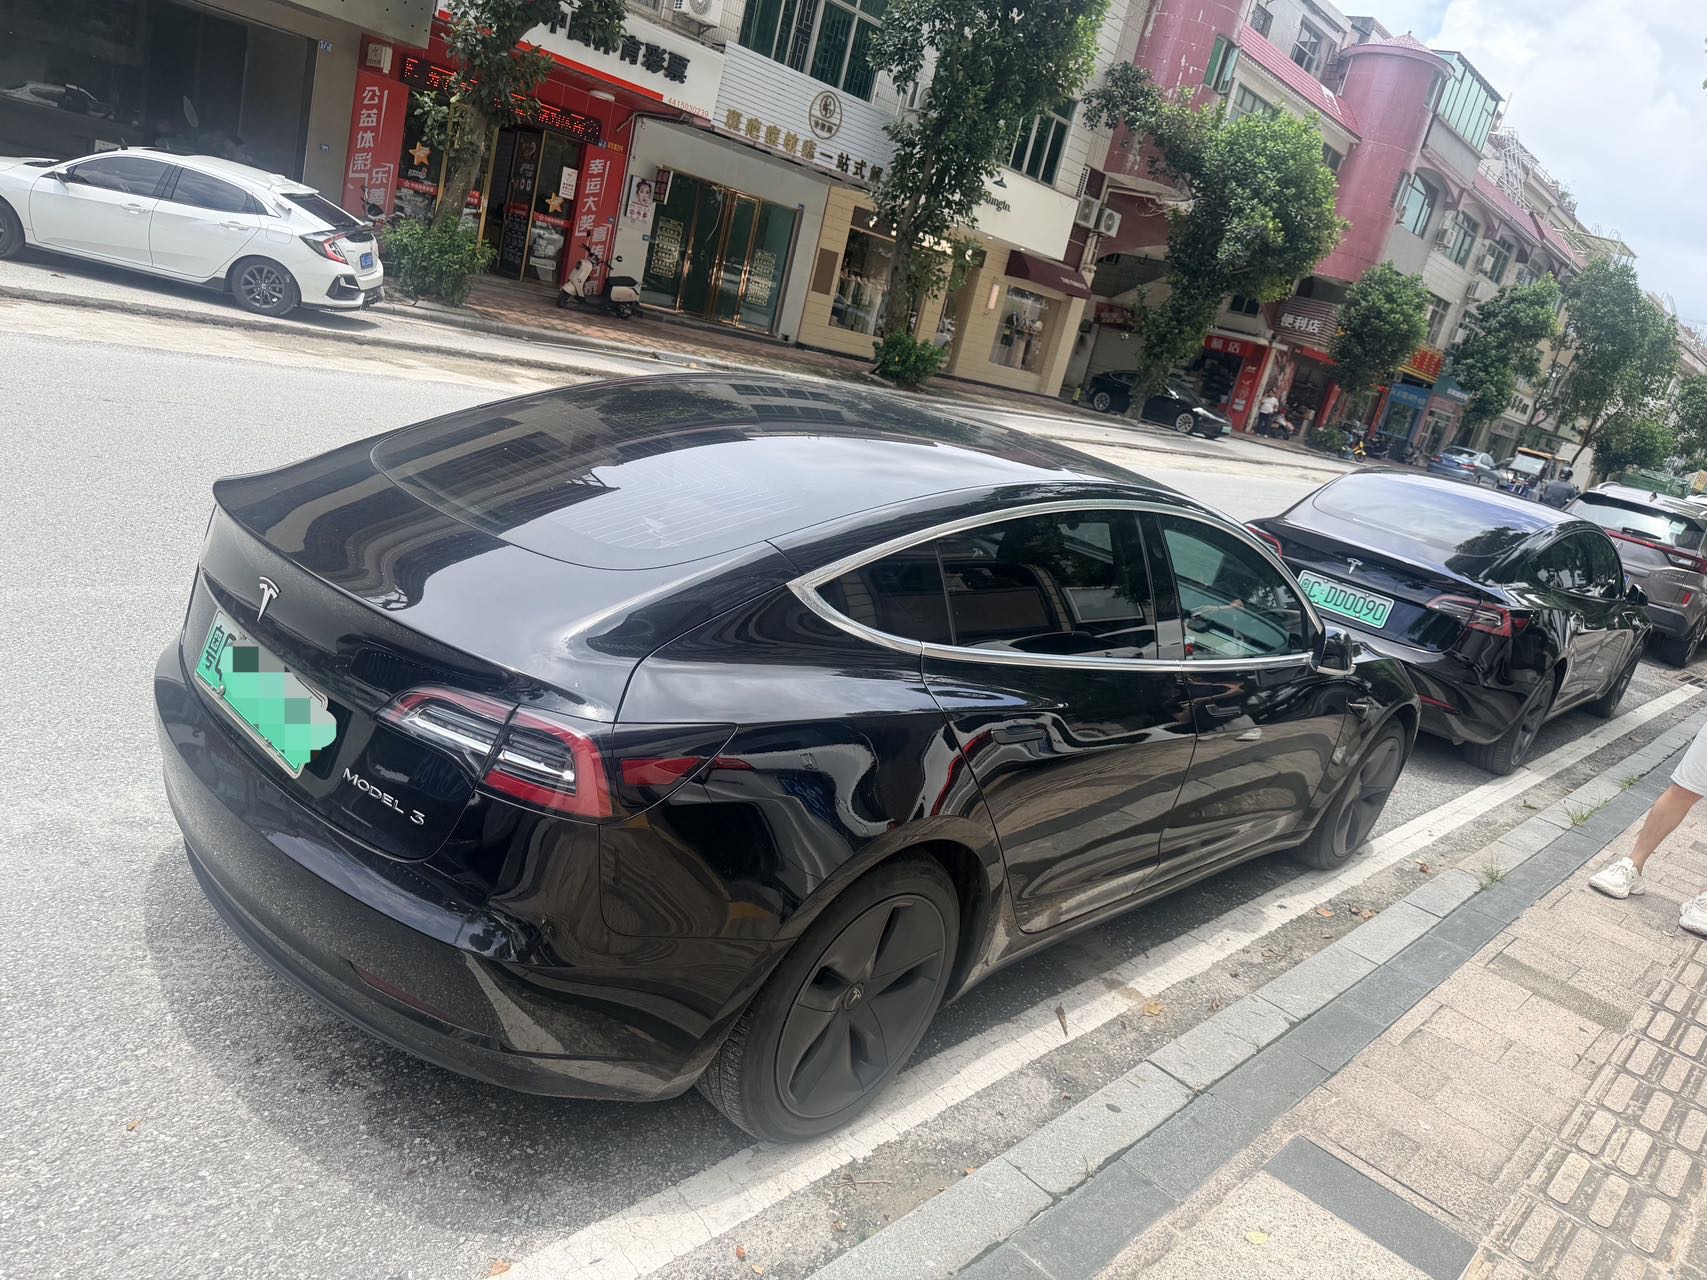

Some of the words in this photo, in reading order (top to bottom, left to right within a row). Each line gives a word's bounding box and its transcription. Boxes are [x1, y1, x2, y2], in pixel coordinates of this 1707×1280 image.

[353, 86, 381, 171] 公益体彩
[578, 159, 605, 230] 幸运大奖
[1280, 313, 1322, 334] 便利店
[343, 767, 404, 814] MODEL
[409, 809, 425, 825] 3
